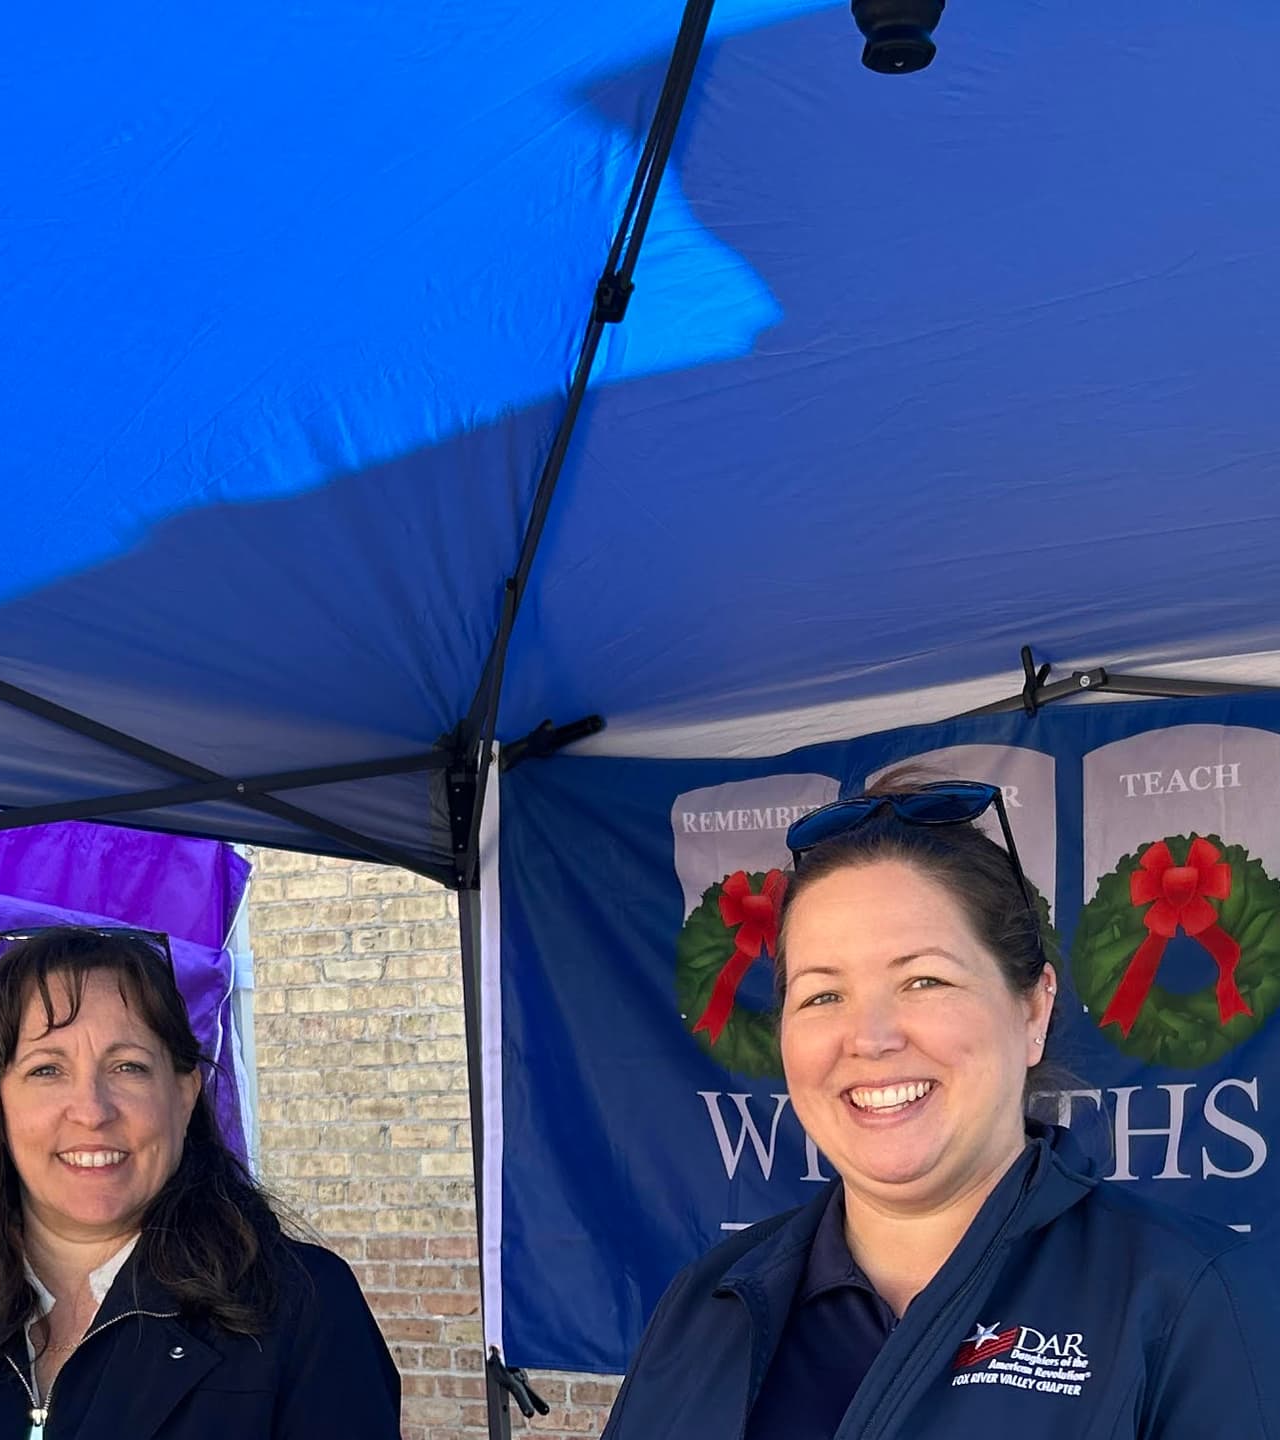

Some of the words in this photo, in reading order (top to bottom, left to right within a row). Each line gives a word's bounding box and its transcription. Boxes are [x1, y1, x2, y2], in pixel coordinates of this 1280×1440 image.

[1120, 763, 1242, 798] TEACH
[682, 805, 823, 834] REMEMBE
[1013, 1326, 1088, 1357] DAR
[988, 1359, 1033, 1375] American
[1060, 1355, 1072, 1367] of
[1072, 1356, 1089, 1368] the
[952, 1373, 971, 1387] FOX
[970, 1372, 998, 1385] RIVER
[1000, 1372, 1036, 1389] VALLEY
[1036, 1380, 1082, 1396] CHAPTER
